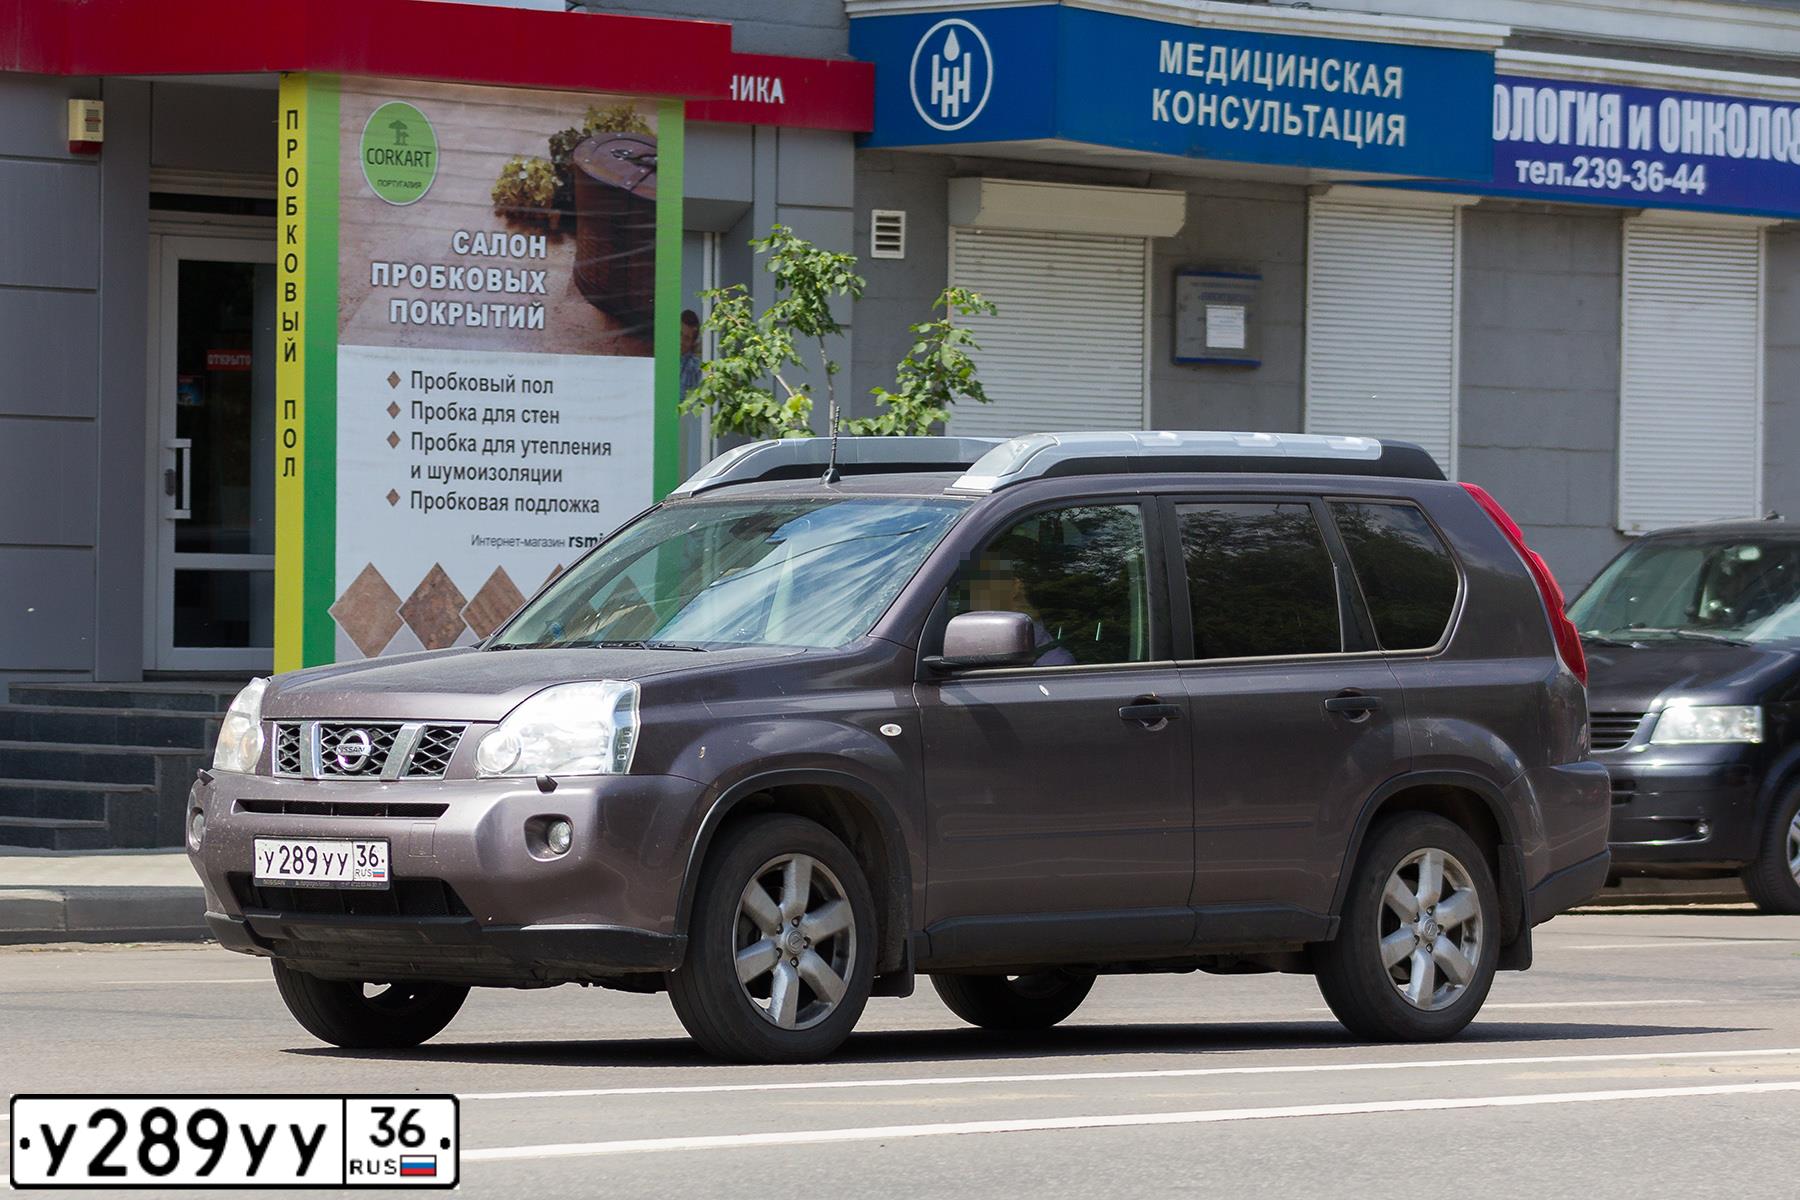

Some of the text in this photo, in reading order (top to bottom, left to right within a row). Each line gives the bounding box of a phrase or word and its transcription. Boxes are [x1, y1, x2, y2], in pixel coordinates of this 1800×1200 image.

[1158, 39, 1404, 100] МЕДИЦИНСКАЯ
[1151, 87, 1407, 150] КОНСУЛЬТАЦИЯ
[1492, 83, 1621, 149] ОЛОГИЯ
[1627, 104, 1651, 151] и
[366, 148, 432, 167] CORKART
[1514, 155, 1706, 195] тел.239-36-44
[452, 229, 547, 258] САЛОН
[370, 262, 547, 294] ПРОБКОВЫХ
[282, 109, 299, 477] ПРОБКОВЫЙ ПОЛ
[389, 299, 546, 330] ПОКРЫТИЙ
[410, 370, 554, 394] Пробковый пол
[410, 400, 560, 425] Пробка для стен
[410, 431, 612, 458] Пробка для утепления
[410, 464, 563, 484] и шумоизоляции
[410, 490, 600, 515] Пробковая подложка
[471, 534, 565, 549] Интернет-магазин
[356, 844, 379, 867] 36
[355, 868, 372, 877] RUS
